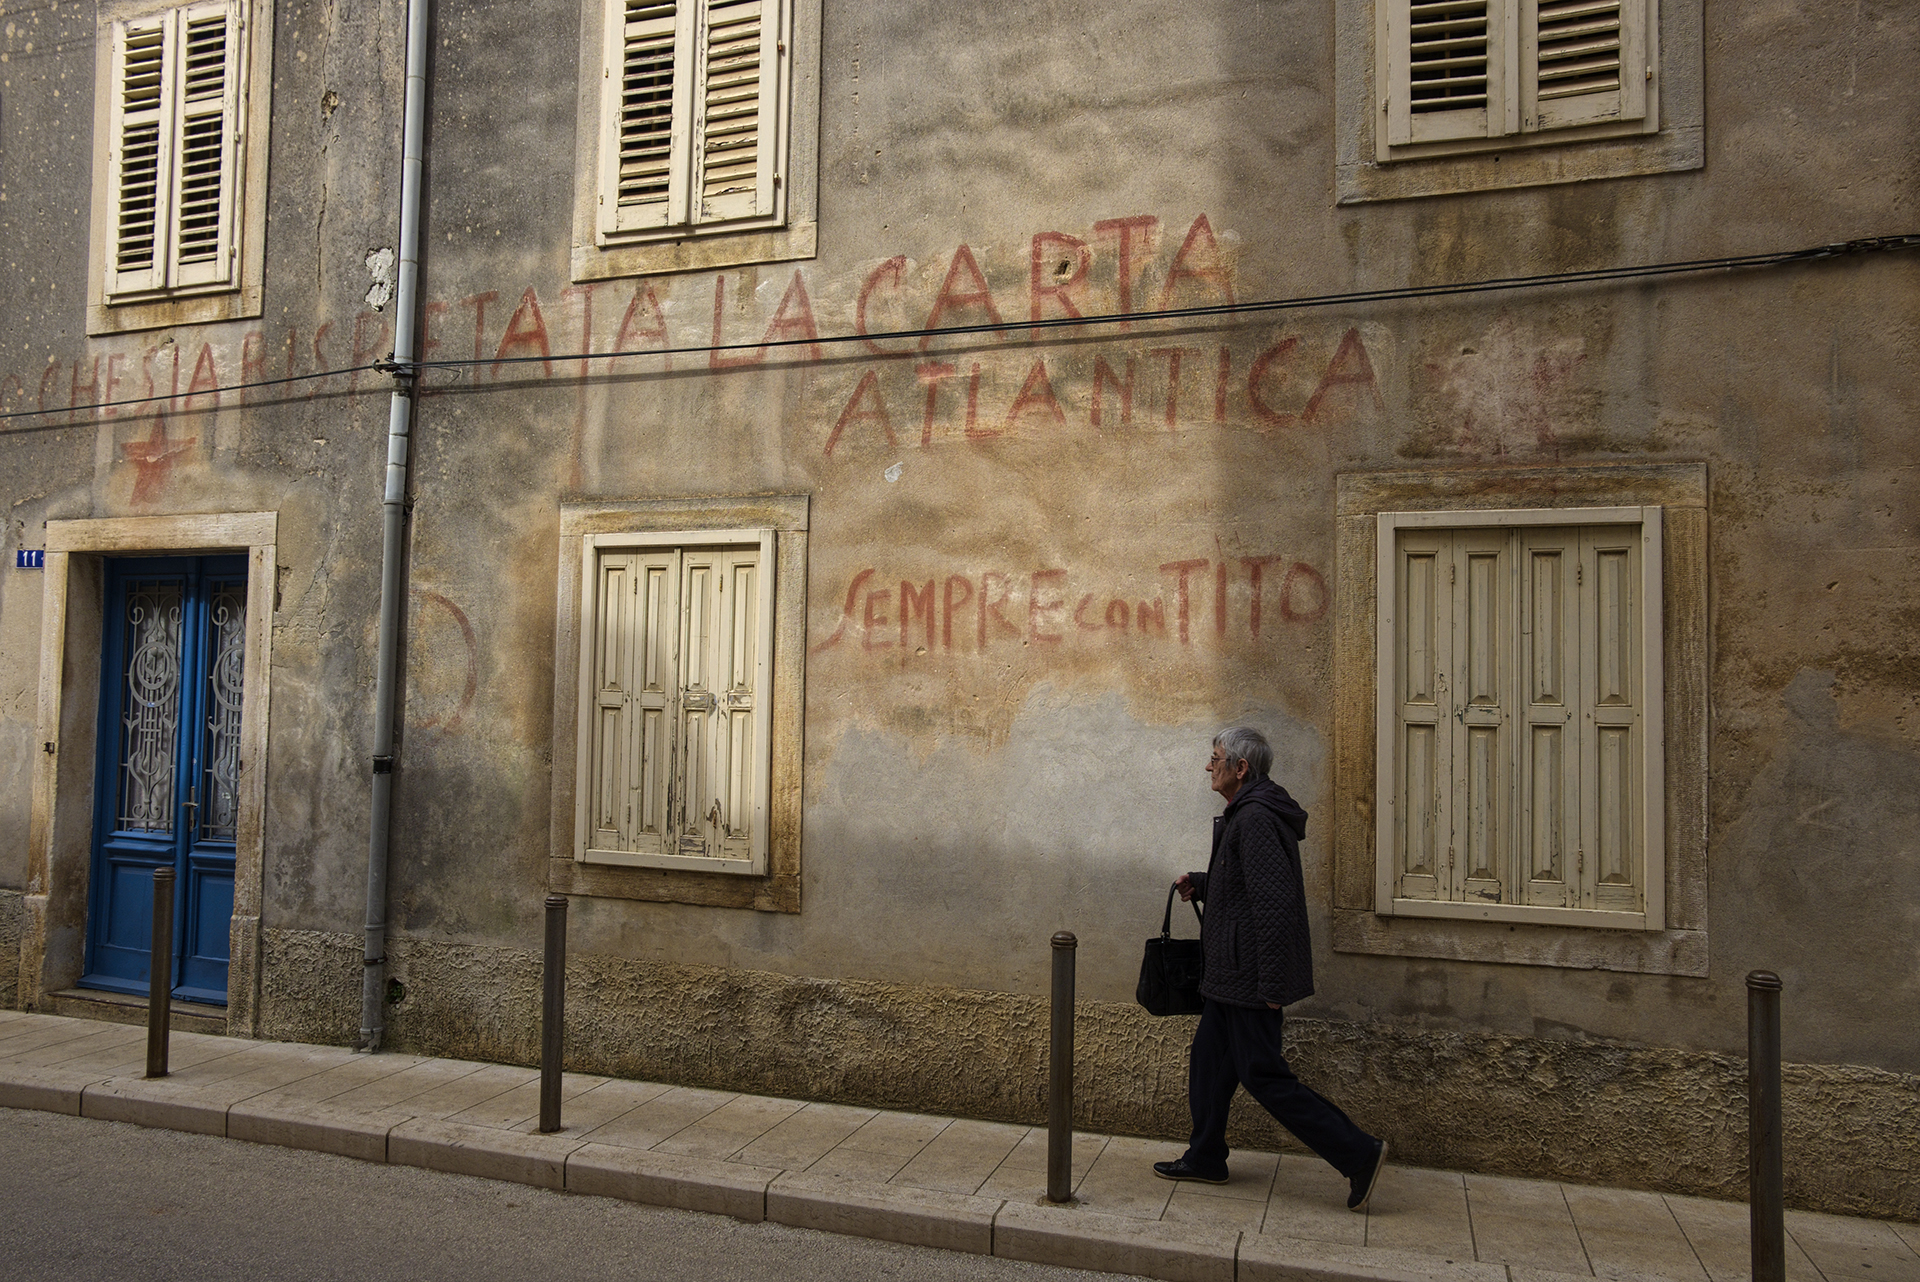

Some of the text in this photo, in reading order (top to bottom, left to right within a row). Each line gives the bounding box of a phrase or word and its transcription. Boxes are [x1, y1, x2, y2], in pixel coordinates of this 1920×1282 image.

[38, 353, 125, 424] CHE
[135, 341, 221, 416] SIA
[709, 268, 822, 374] LA
[854, 213, 1238, 360] CARTA
[825, 327, 1386, 458] ATLANTICA
[22, 550, 37, 567] 11
[807, 568, 1067, 652] SEMPRE
[1158, 554, 1332, 646] TITO
